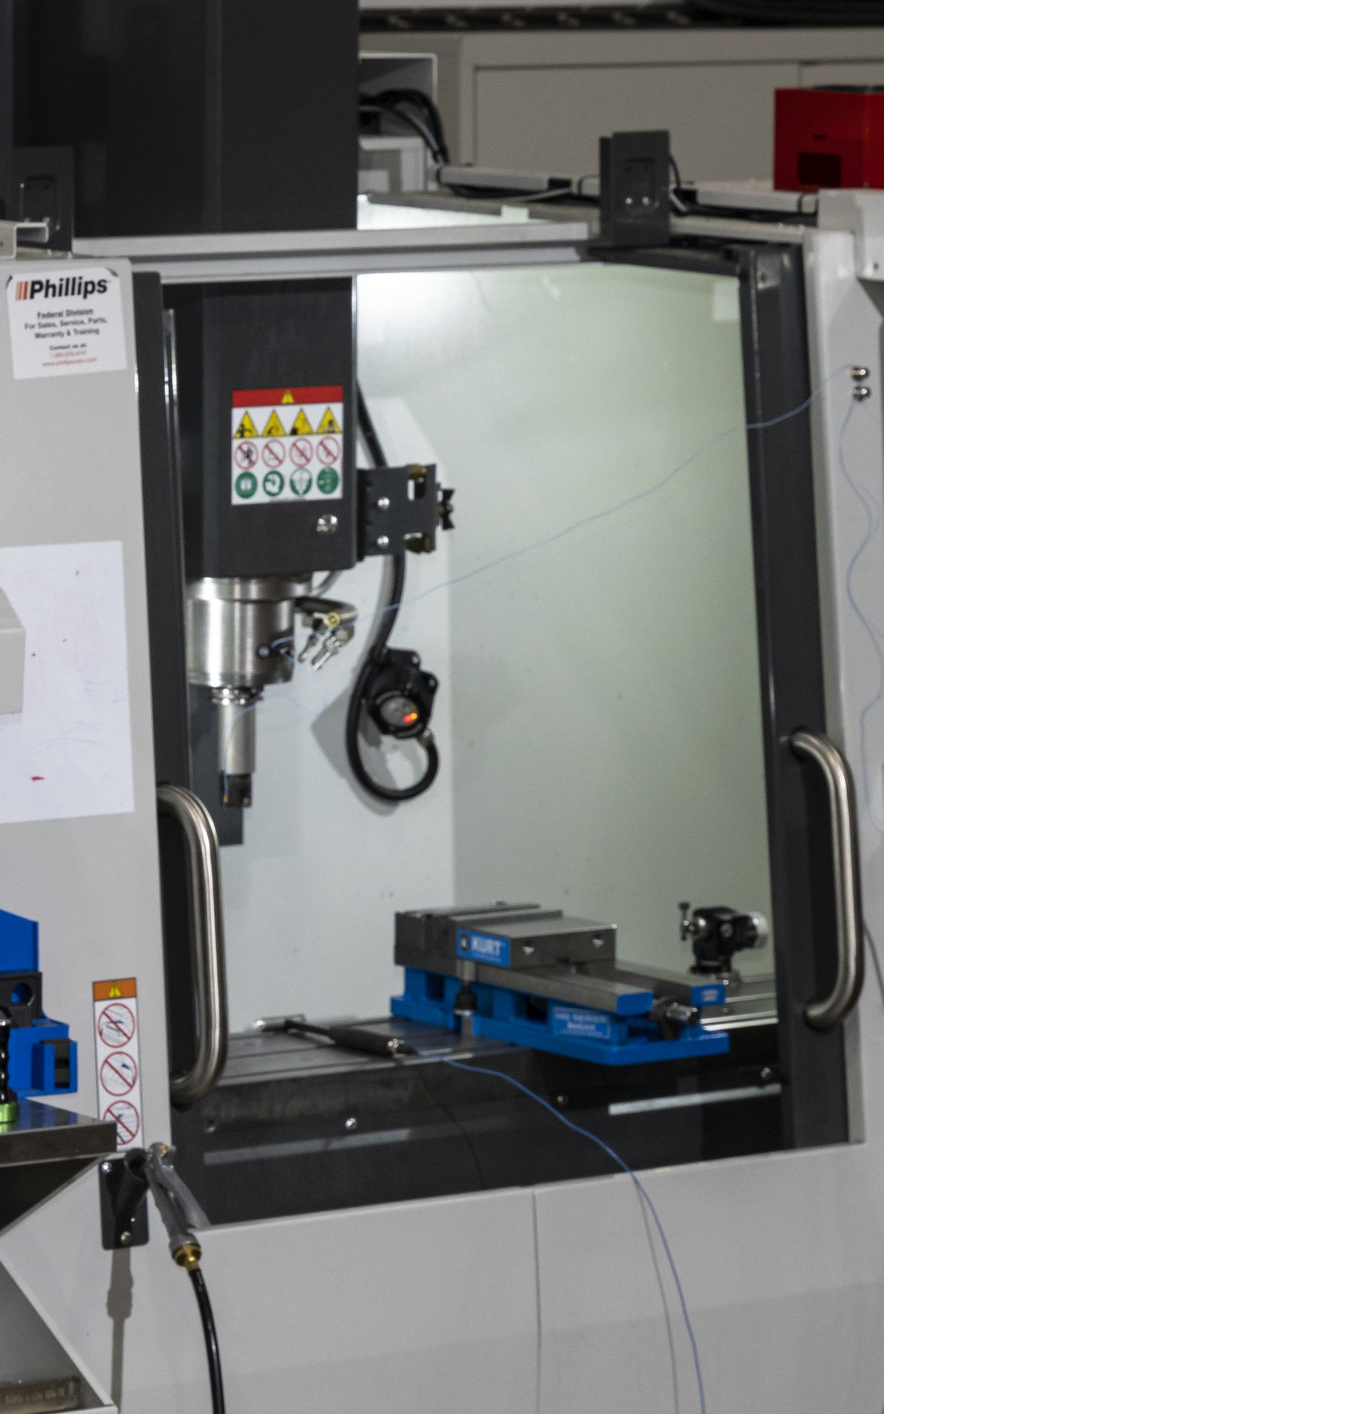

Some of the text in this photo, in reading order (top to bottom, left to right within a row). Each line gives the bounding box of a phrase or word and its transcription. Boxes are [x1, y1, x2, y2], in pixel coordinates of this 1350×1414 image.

[29, 276, 108, 300] Phillips
[36, 308, 94, 320] Federal Division
[37, 321, 58, 329] Sales,
[59, 319, 86, 327] Service,
[87, 316, 108, 324] Parts,
[34, 331, 64, 339] Warranty
[73, 328, 100, 336] Training
[471, 935, 502, 956] KURT
